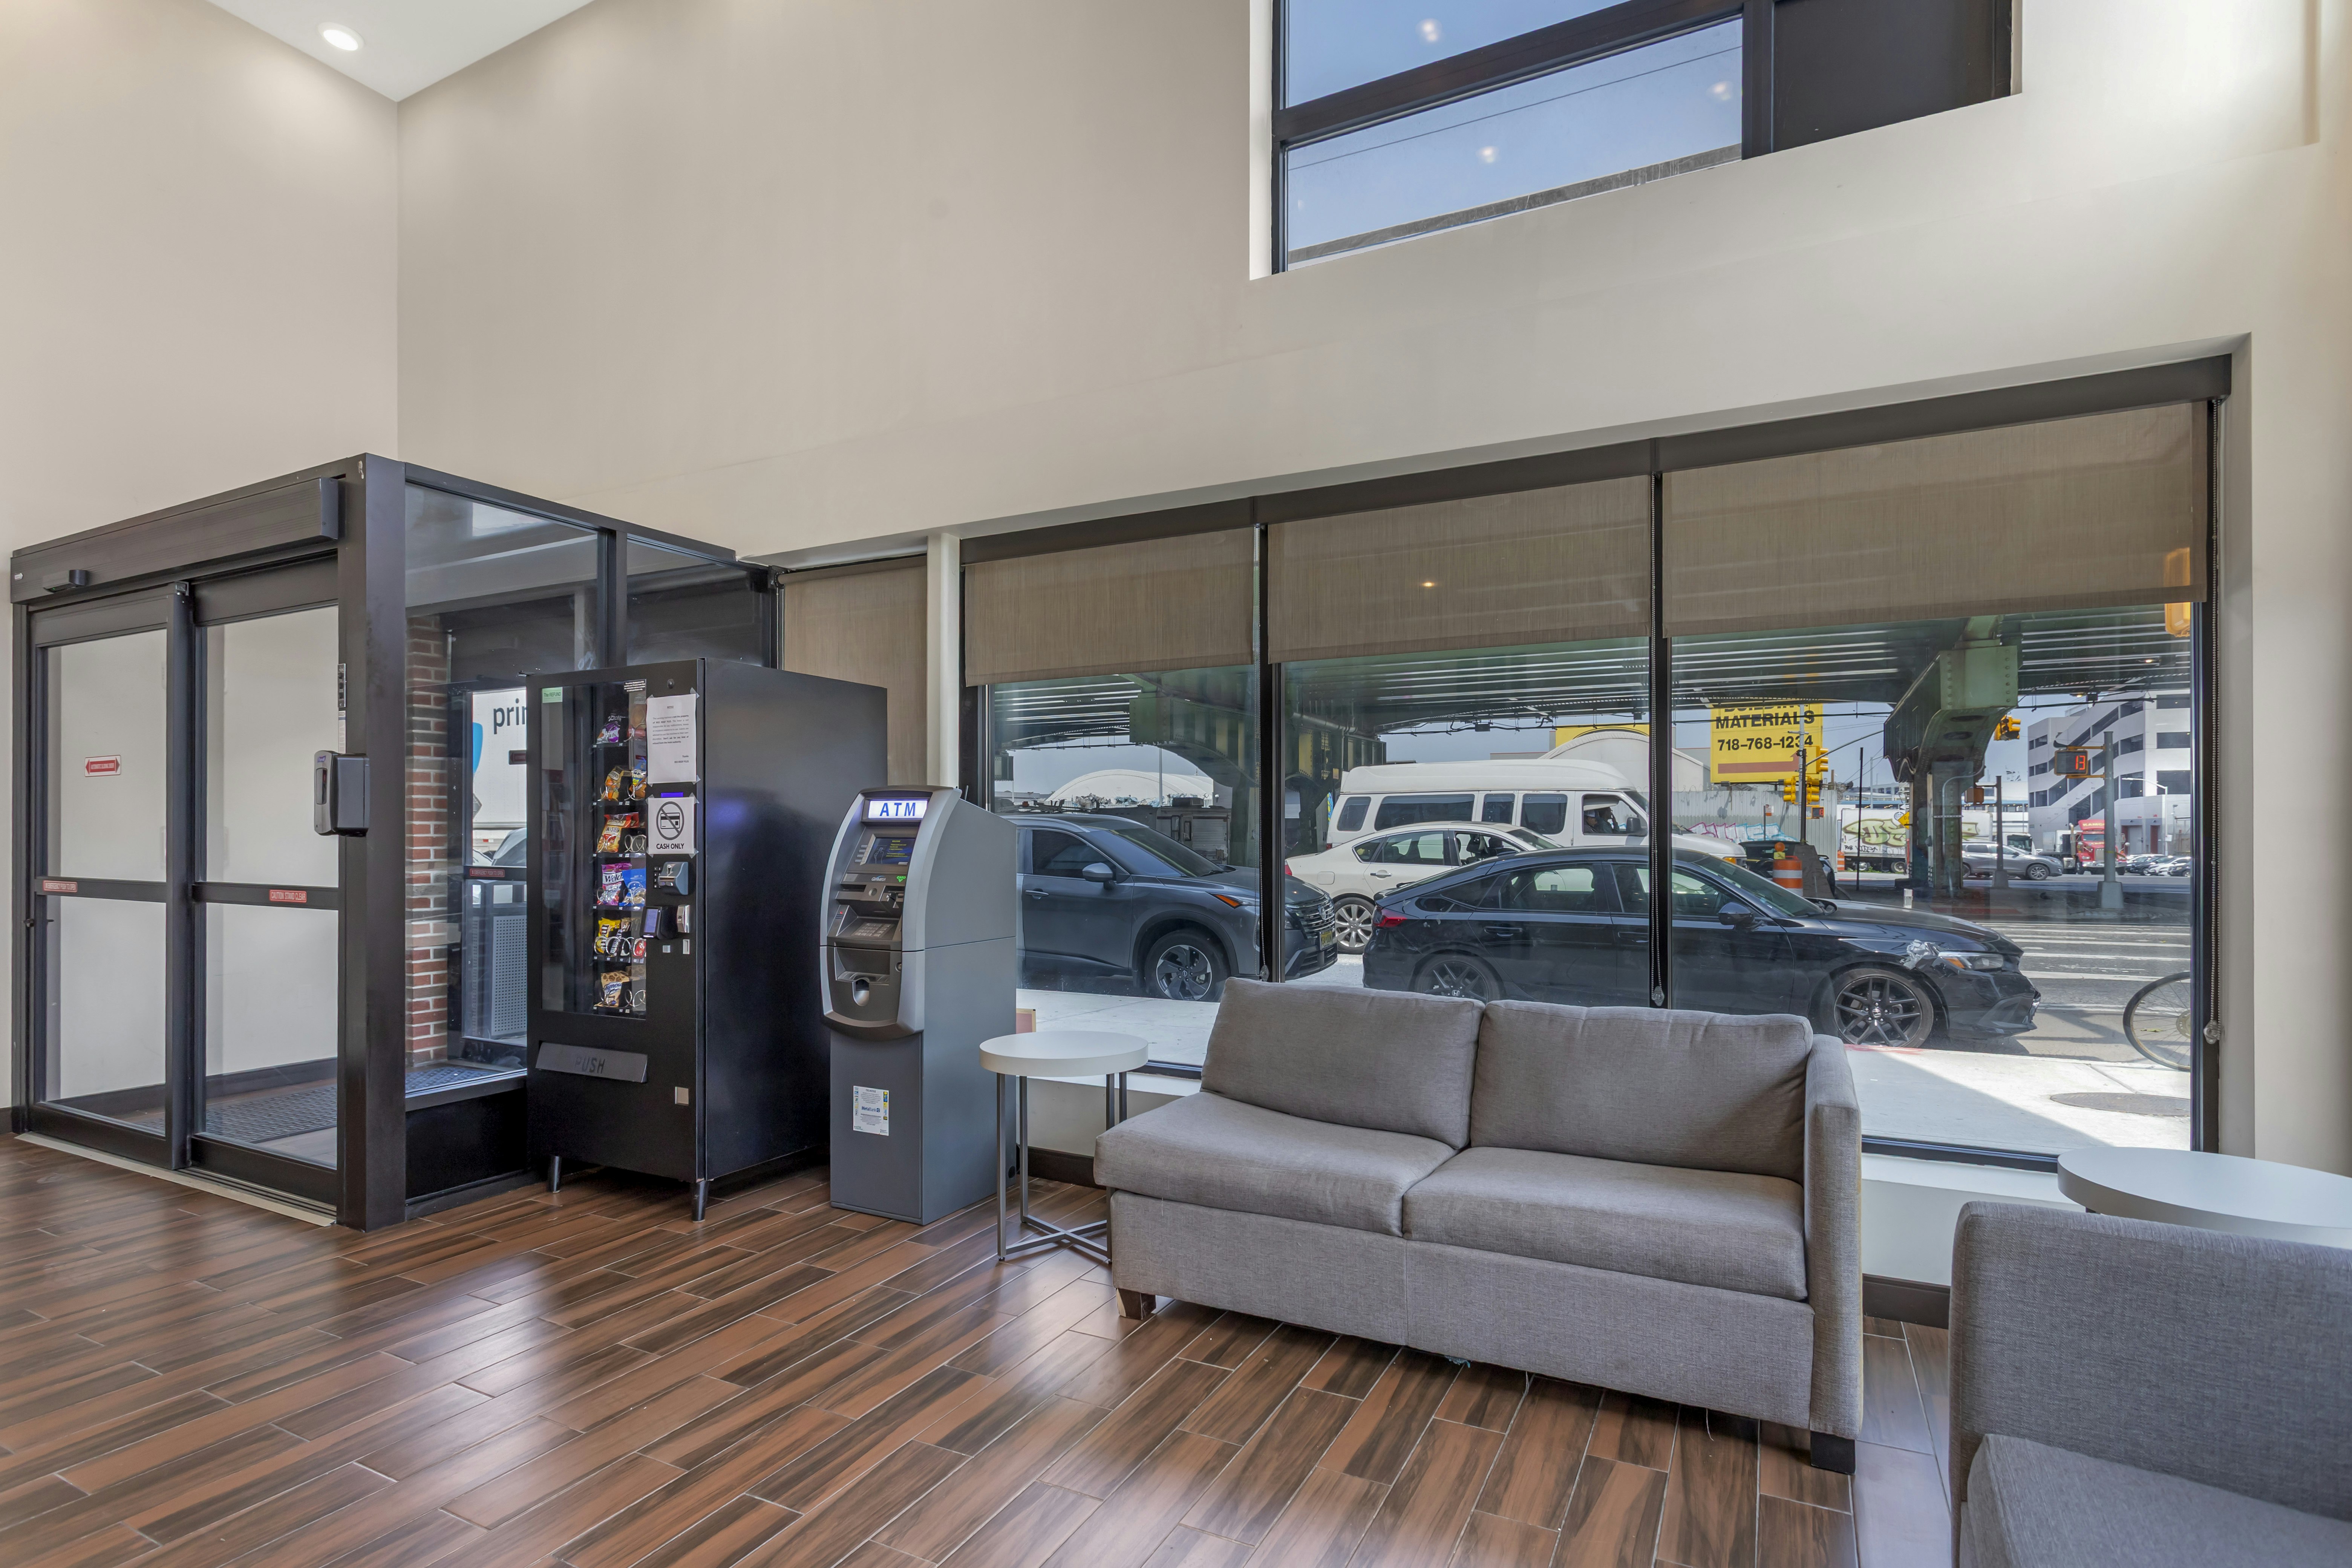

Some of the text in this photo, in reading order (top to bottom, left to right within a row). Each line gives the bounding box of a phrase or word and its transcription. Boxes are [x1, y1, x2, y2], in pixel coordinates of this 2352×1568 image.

[1716, 710, 1815, 729] MATERIALS
[2075, 755, 2086, 770] 13
[880, 803, 916, 816] ATM
[575, 1056, 605, 1074] PUSH
